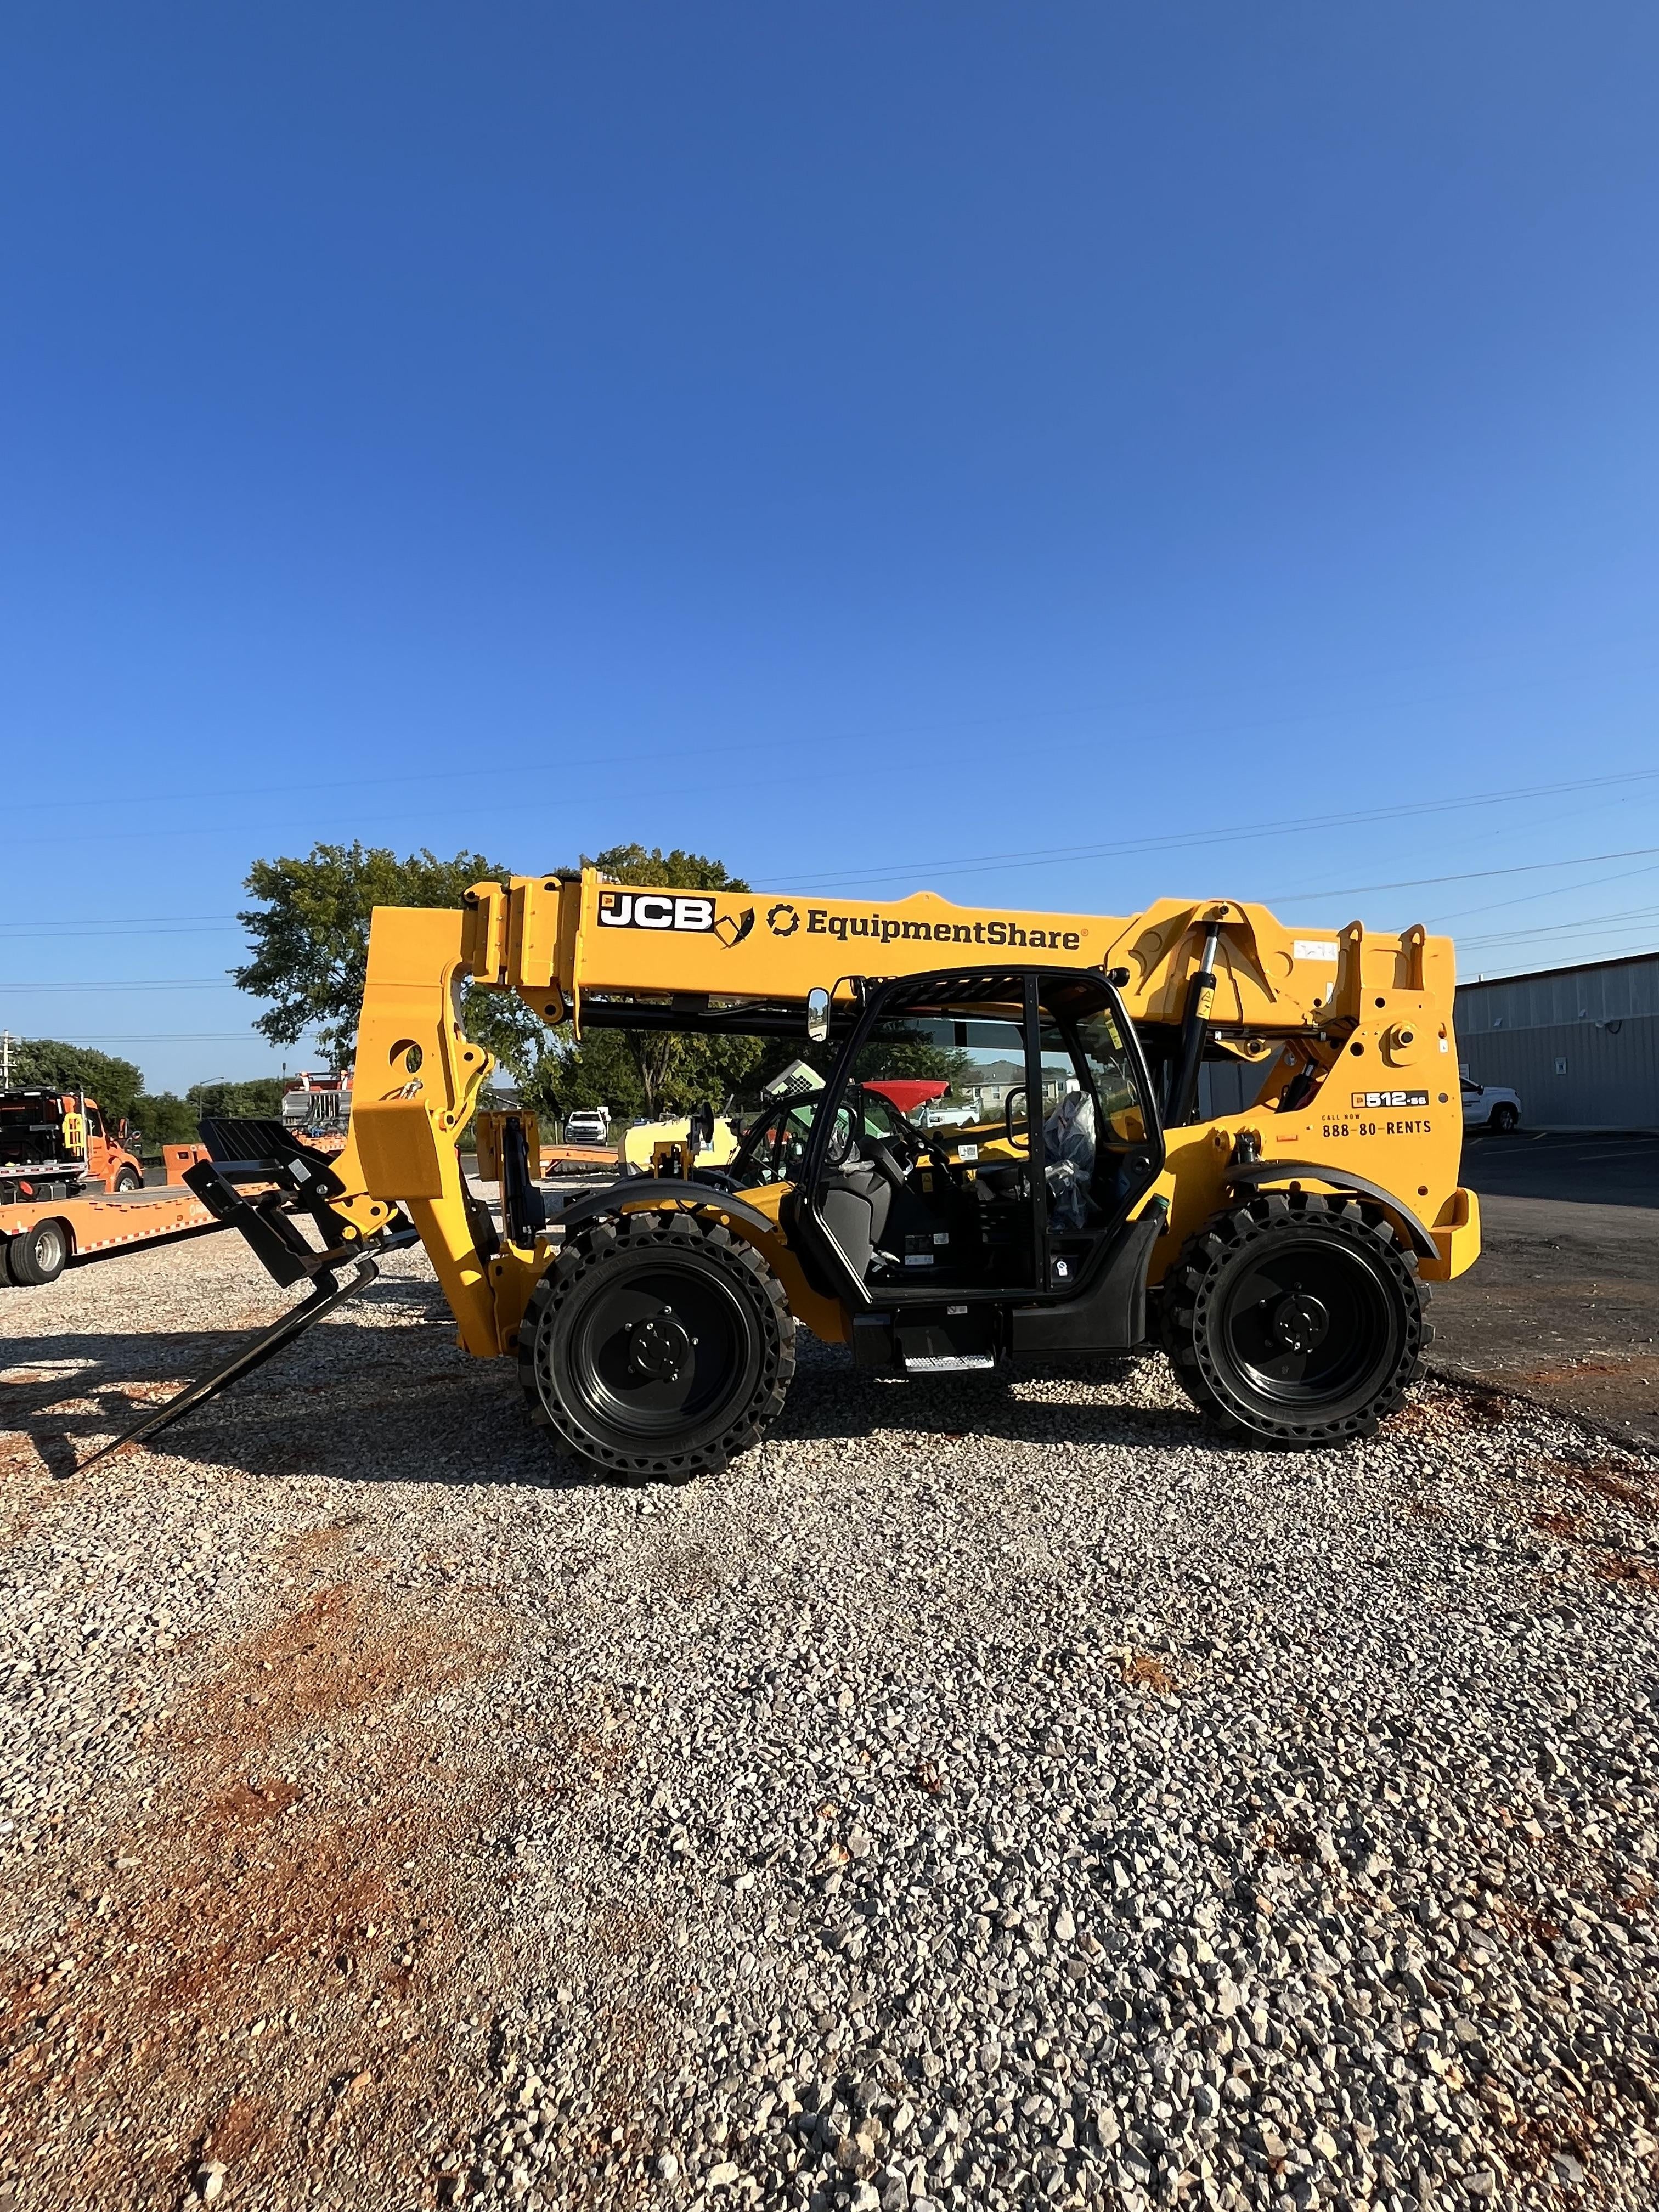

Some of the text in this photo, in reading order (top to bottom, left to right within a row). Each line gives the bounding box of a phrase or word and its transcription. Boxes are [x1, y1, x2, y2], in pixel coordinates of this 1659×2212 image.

[601, 895, 712, 929] JCB
[806, 910, 1080, 950] EquipmentShare
[1323, 1120, 1431, 1137] 888-80-RENTS
